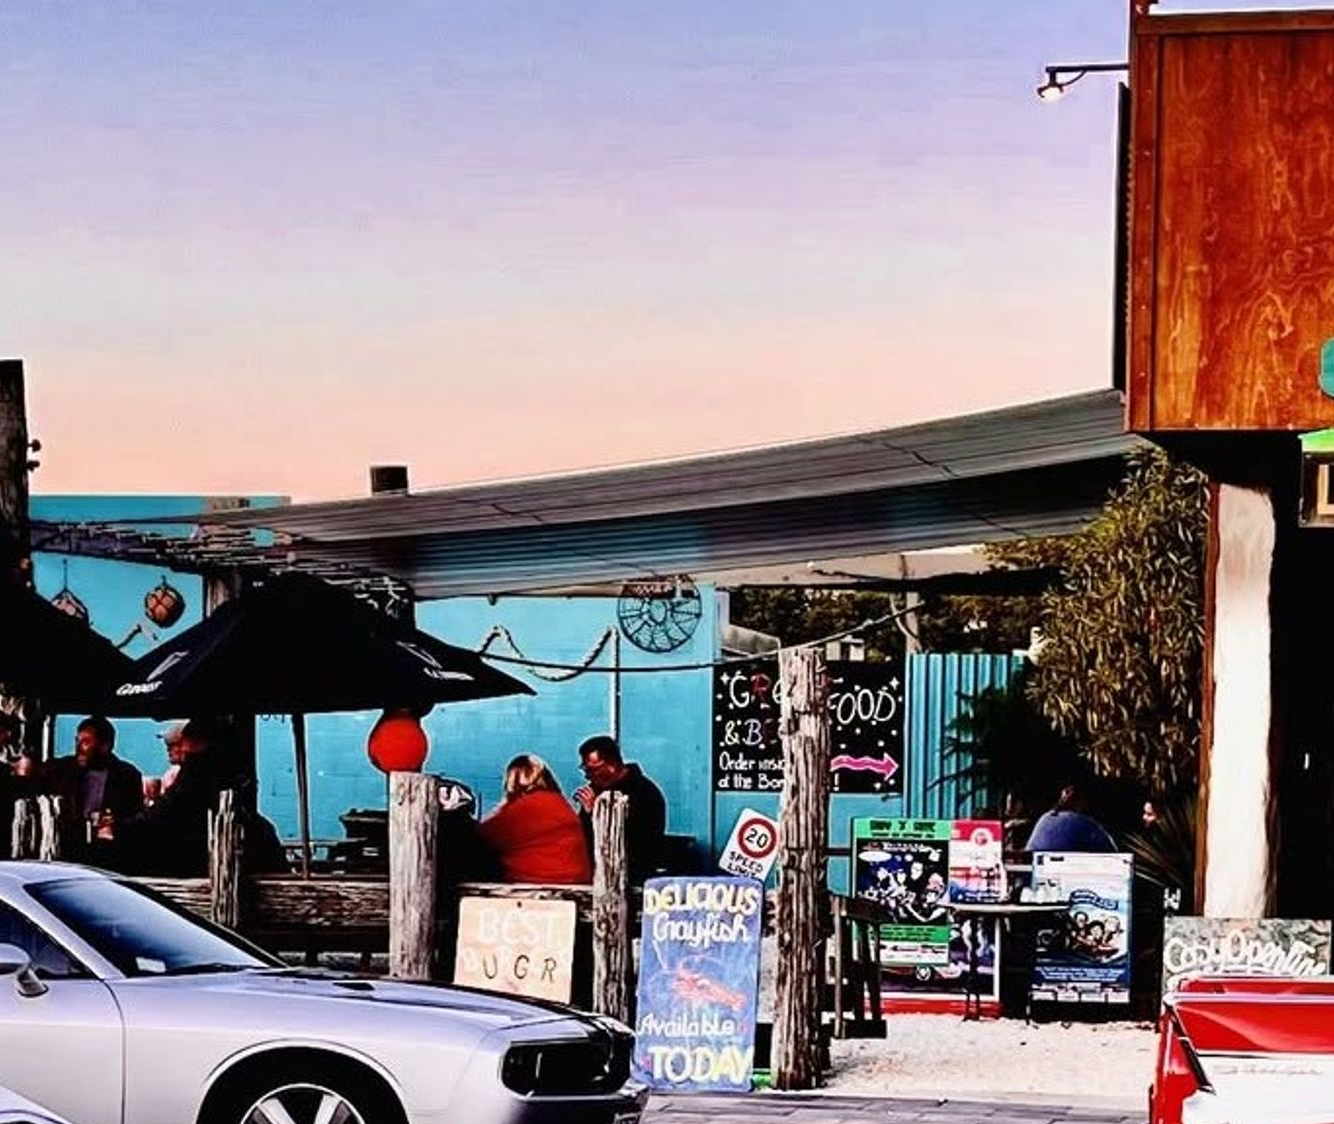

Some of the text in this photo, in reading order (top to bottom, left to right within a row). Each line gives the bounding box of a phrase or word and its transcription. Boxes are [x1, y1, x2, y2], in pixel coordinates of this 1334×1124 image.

[828, 688, 897, 725] OOD
[719, 750, 755, 771] Order
[733, 773, 753, 789] the
[745, 827, 769, 849] 20
[729, 850, 764, 874] SPEED
[643, 881, 761, 917] DELICIOUS
[652, 911, 750, 948] Crayfish
[637, 1012, 735, 1038] Available
[648, 1045, 755, 1085] TODAY
